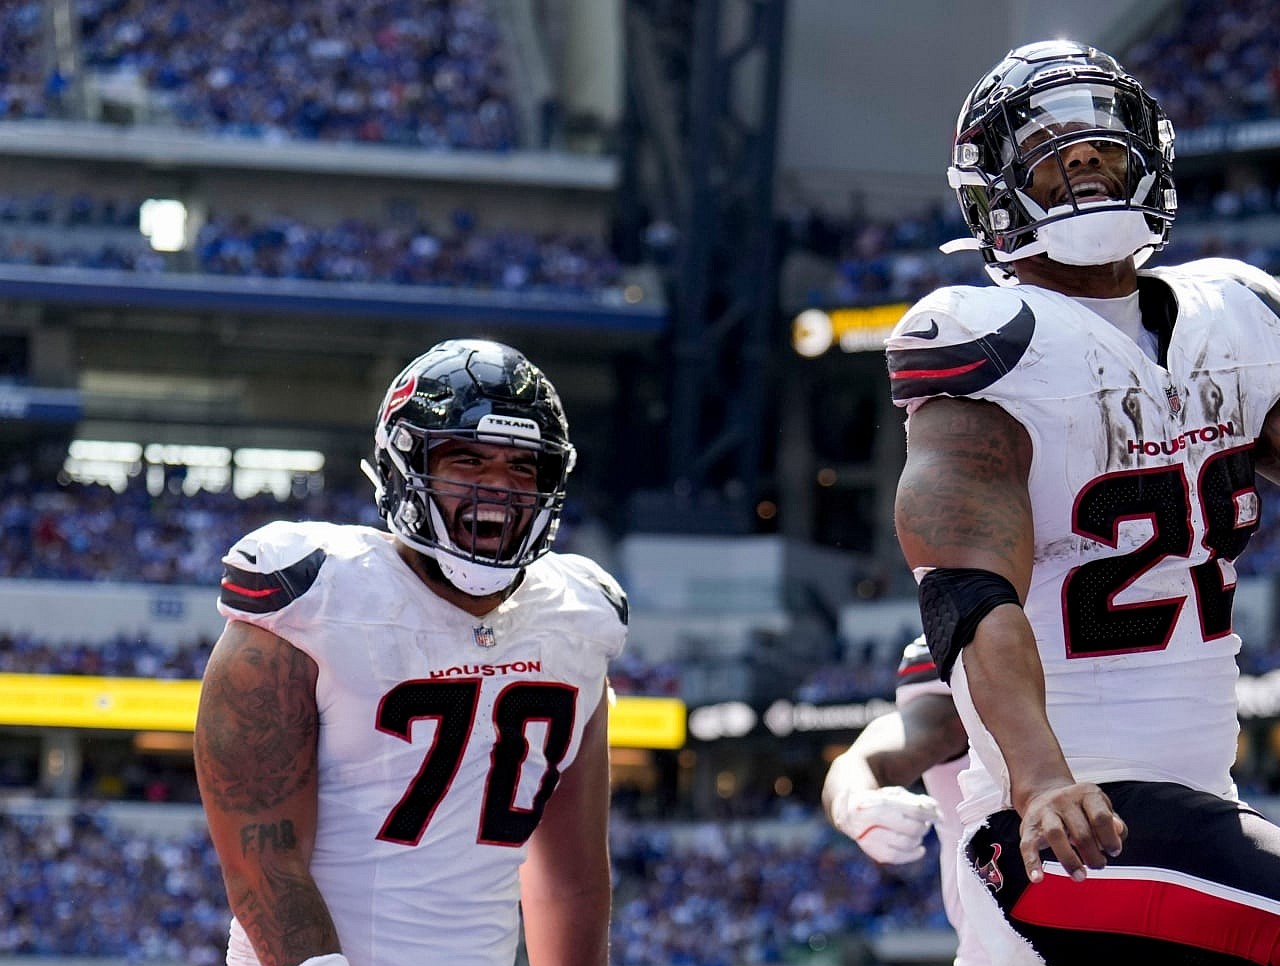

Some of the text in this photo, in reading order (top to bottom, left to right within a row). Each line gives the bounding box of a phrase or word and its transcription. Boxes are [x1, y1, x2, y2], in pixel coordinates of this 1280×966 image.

[487, 418, 536, 430] TEXANS
[1127, 421, 1235, 456] HOUSTON
[375, 677, 580, 848] 70
